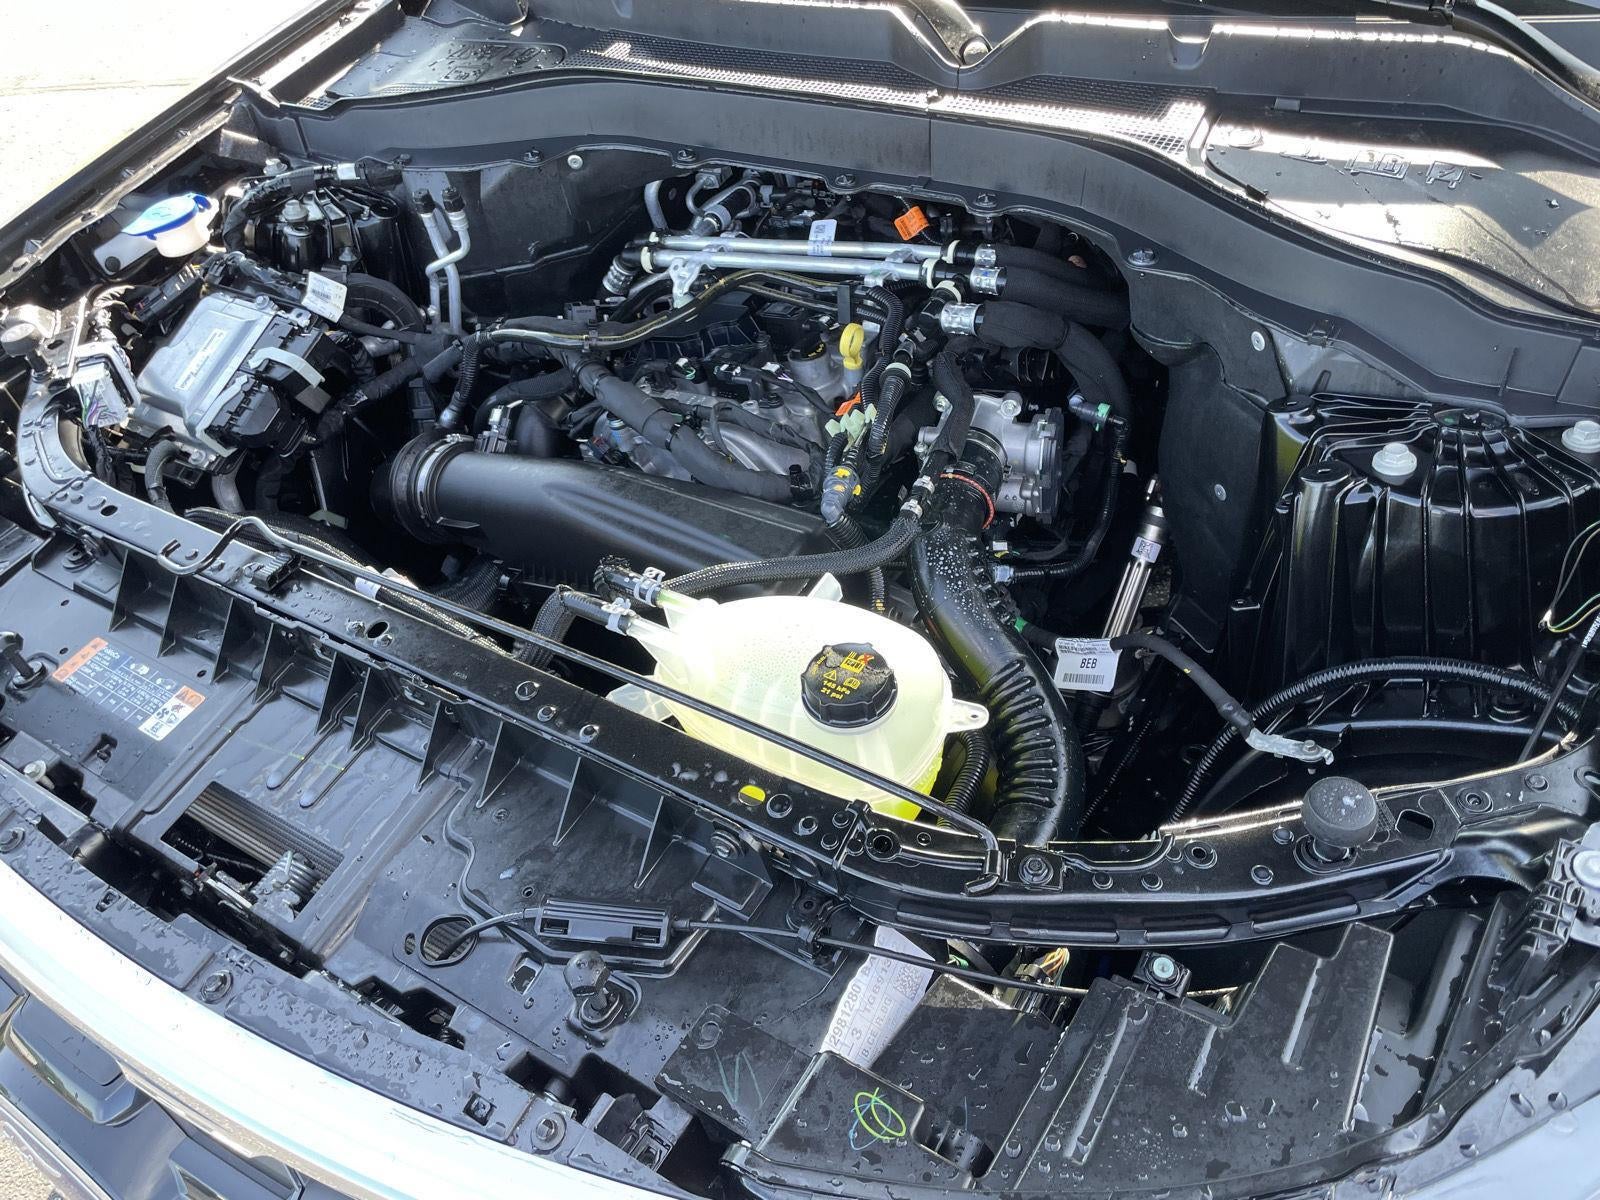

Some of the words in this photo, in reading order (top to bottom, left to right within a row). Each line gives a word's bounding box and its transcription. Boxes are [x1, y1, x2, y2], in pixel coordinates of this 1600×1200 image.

[1080, 657, 1097, 669] BEB
[820, 687, 830, 695] 21
[830, 692, 843, 700] psi
[836, 685, 850, 695] kPa
[829, 983, 862, 1047] 2981280
